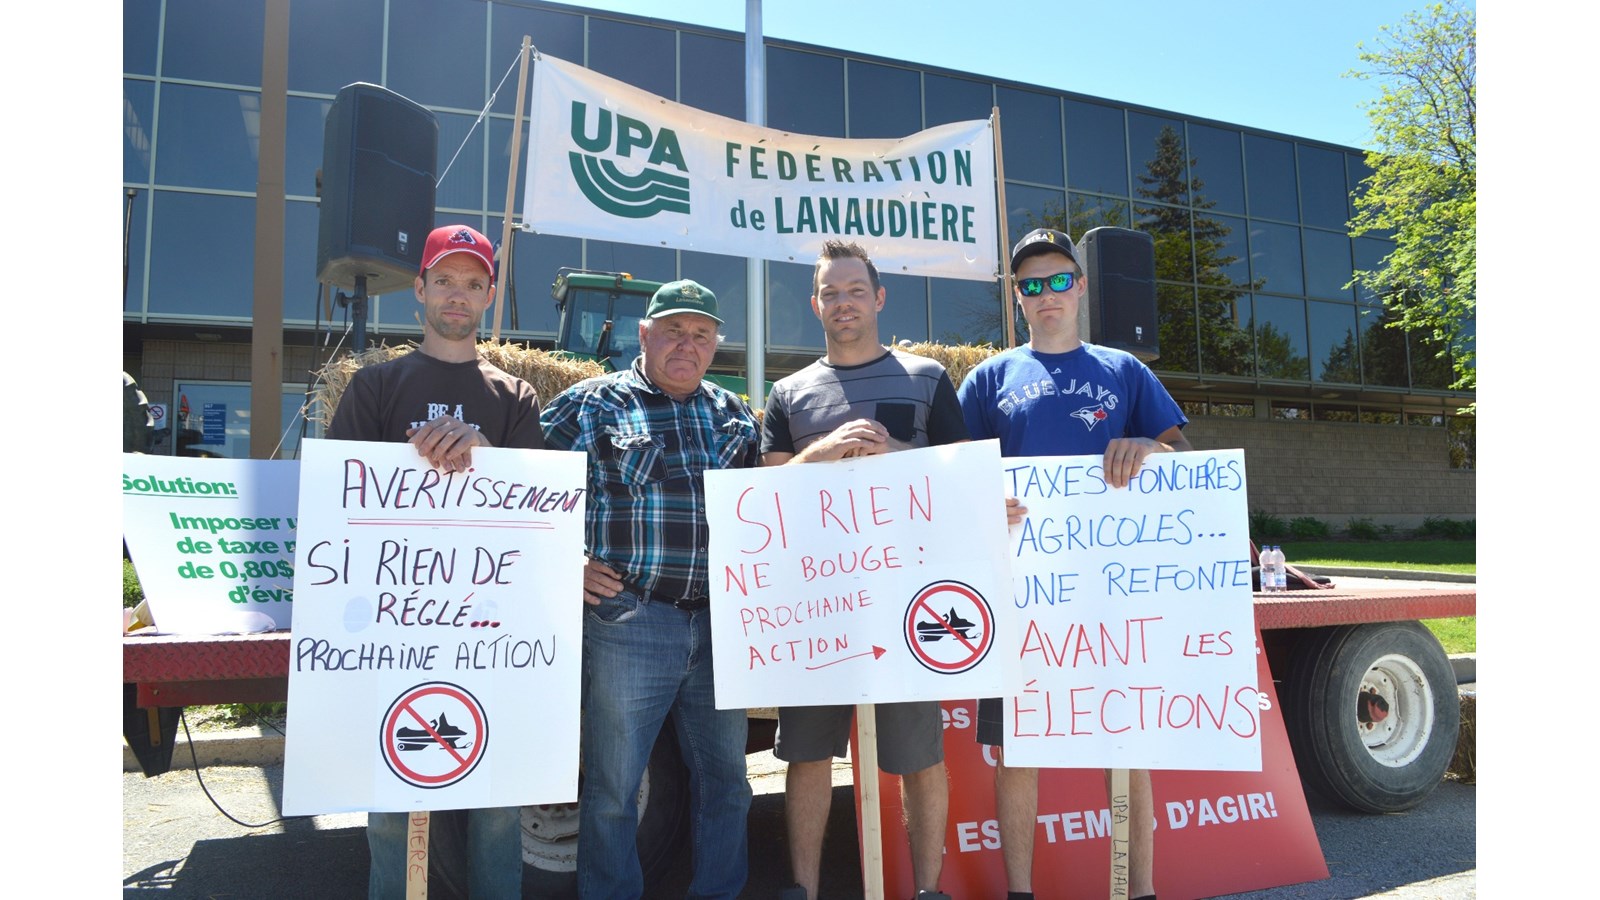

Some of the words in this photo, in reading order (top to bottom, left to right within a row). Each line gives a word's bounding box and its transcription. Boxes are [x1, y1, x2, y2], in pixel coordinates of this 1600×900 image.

[571, 100, 689, 173] UPA
[726, 139, 972, 187] FÉDÉRATION
[730, 199, 766, 231] de
[774, 191, 976, 244] LANAUDIÈRE
[996, 380, 1055, 416] BLUE
[1062, 379, 1119, 410] JAYS
[1005, 465, 1108, 499] TAXES
[169, 512, 281, 534] Imposer
[736, 486, 787, 555] SI
[819, 475, 932, 534] RIEN
[176, 537, 213, 554] de
[217, 537, 279, 554] taxe
[177, 561, 214, 579] de
[472, 547, 522, 585] DE
[725, 562, 772, 597] NE
[1103, 560, 1250, 597] REFONTE
[740, 590, 873, 636] PROCHAINE
[749, 634, 849, 670] ACTION
[1020, 616, 1163, 667] AVANT
[1183, 631, 1233, 657] LES
[1113, 795, 1129, 825] UPA
[1165, 791, 1278, 830] D'AGIR!
